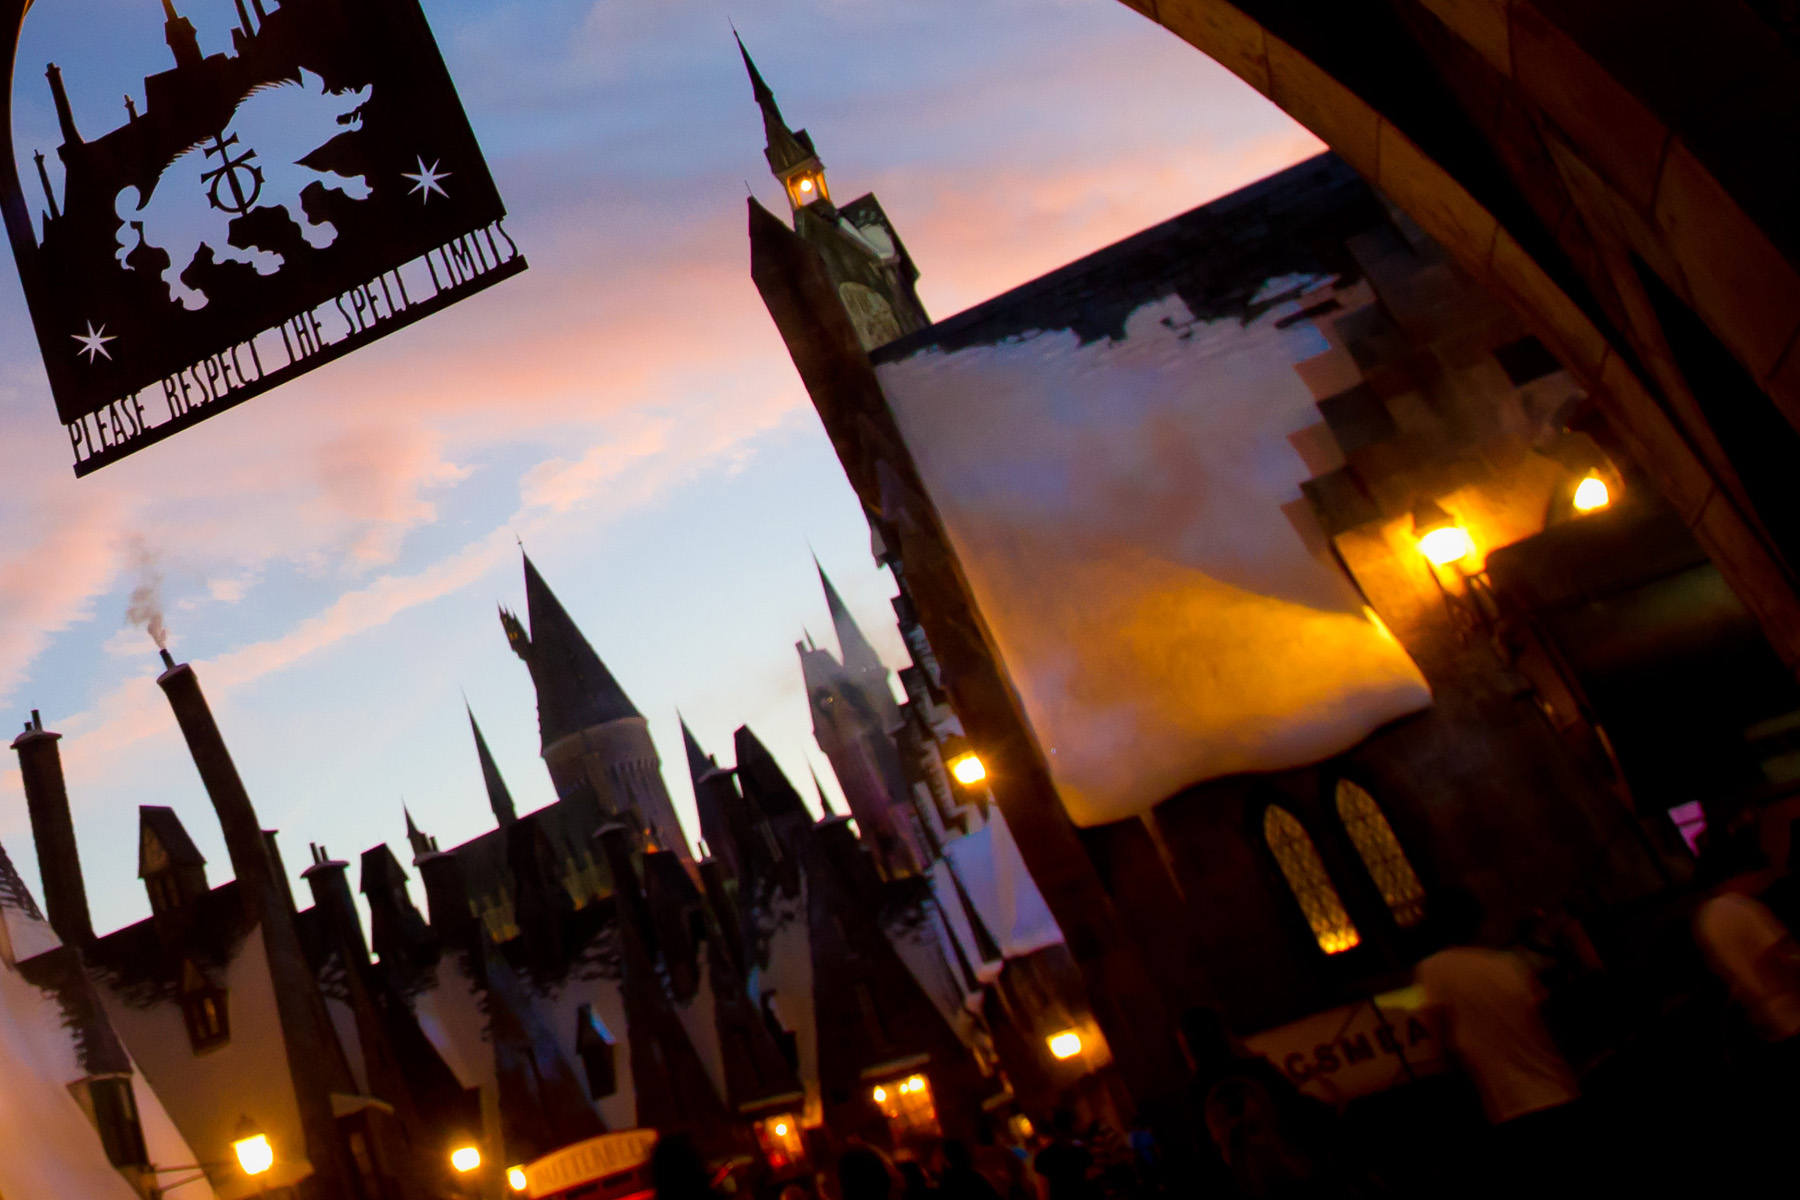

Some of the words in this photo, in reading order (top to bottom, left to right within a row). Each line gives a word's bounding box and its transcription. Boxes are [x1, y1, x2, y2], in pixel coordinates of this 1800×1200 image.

[67, 388, 152, 463] PLEASE
[161, 336, 264, 422] RESPECT
[273, 306, 330, 364] THE
[334, 267, 419, 337] SPELL
[425, 215, 519, 291] LIMITS
